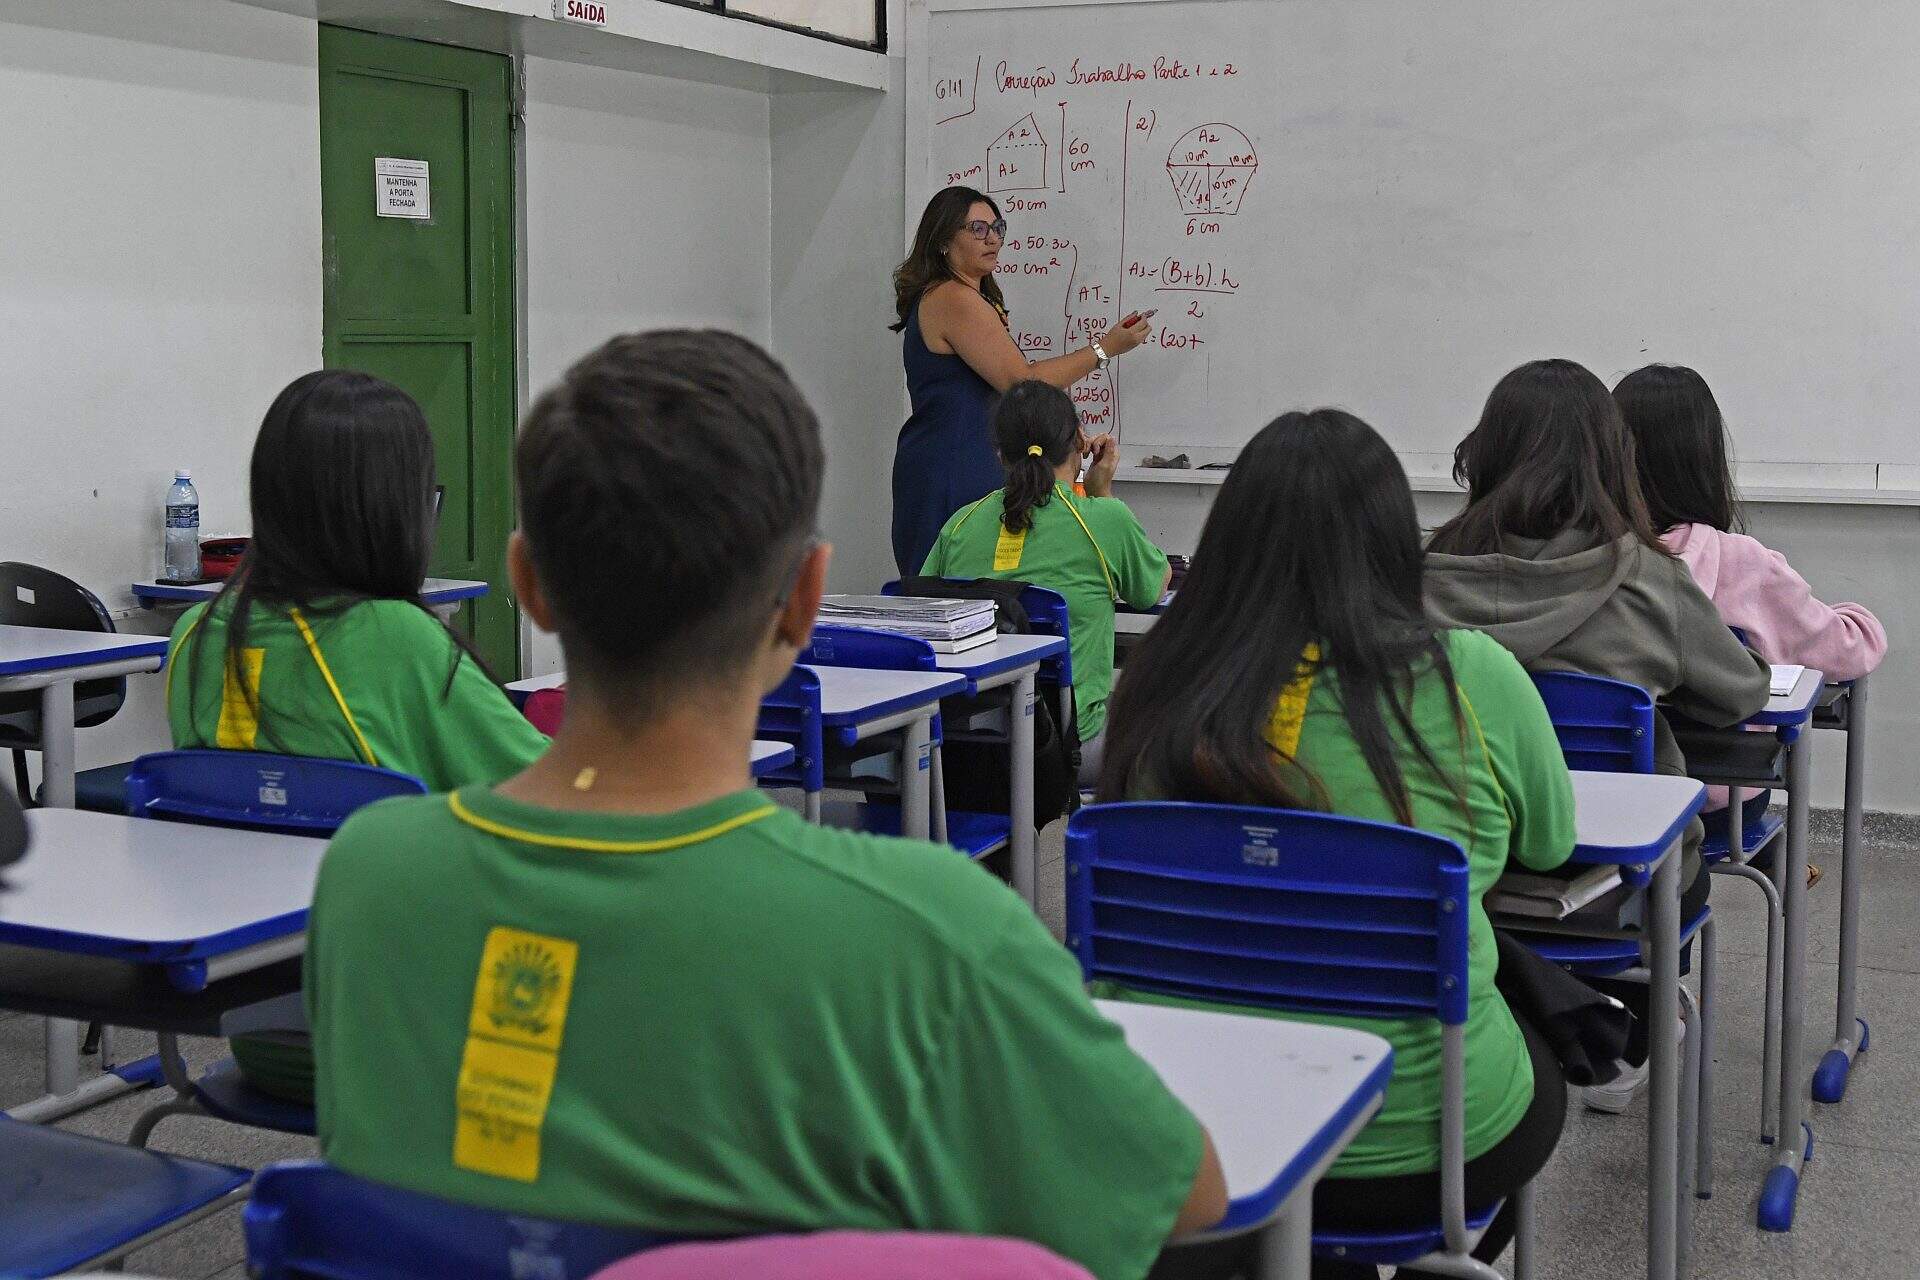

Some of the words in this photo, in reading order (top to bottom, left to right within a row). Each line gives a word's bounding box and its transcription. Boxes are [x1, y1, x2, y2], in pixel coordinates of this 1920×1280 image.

[567, 0, 605, 23] SAÍDA
[996, 60, 1055, 98] Correção
[1066, 58, 1146, 84] Trabalho
[1154, 56, 1189, 79] Parte
[1196, 65, 1200, 76] 1
[1224, 63, 1237, 75] 2
[1199, 129, 1220, 143] A2
[1068, 138, 1089, 155] 60
[1071, 160, 1095, 171] cm
[386, 177, 417, 187] MANTENHA
[389, 188, 394, 196] A
[395, 188, 414, 197] PORTA
[389, 198, 416, 207] FECHADA
[1188, 301, 1204, 318] 2
[1078, 318, 1107, 331] 1500
[1018, 332, 1052, 346] 1500
[1074, 386, 1109, 402] 2250
